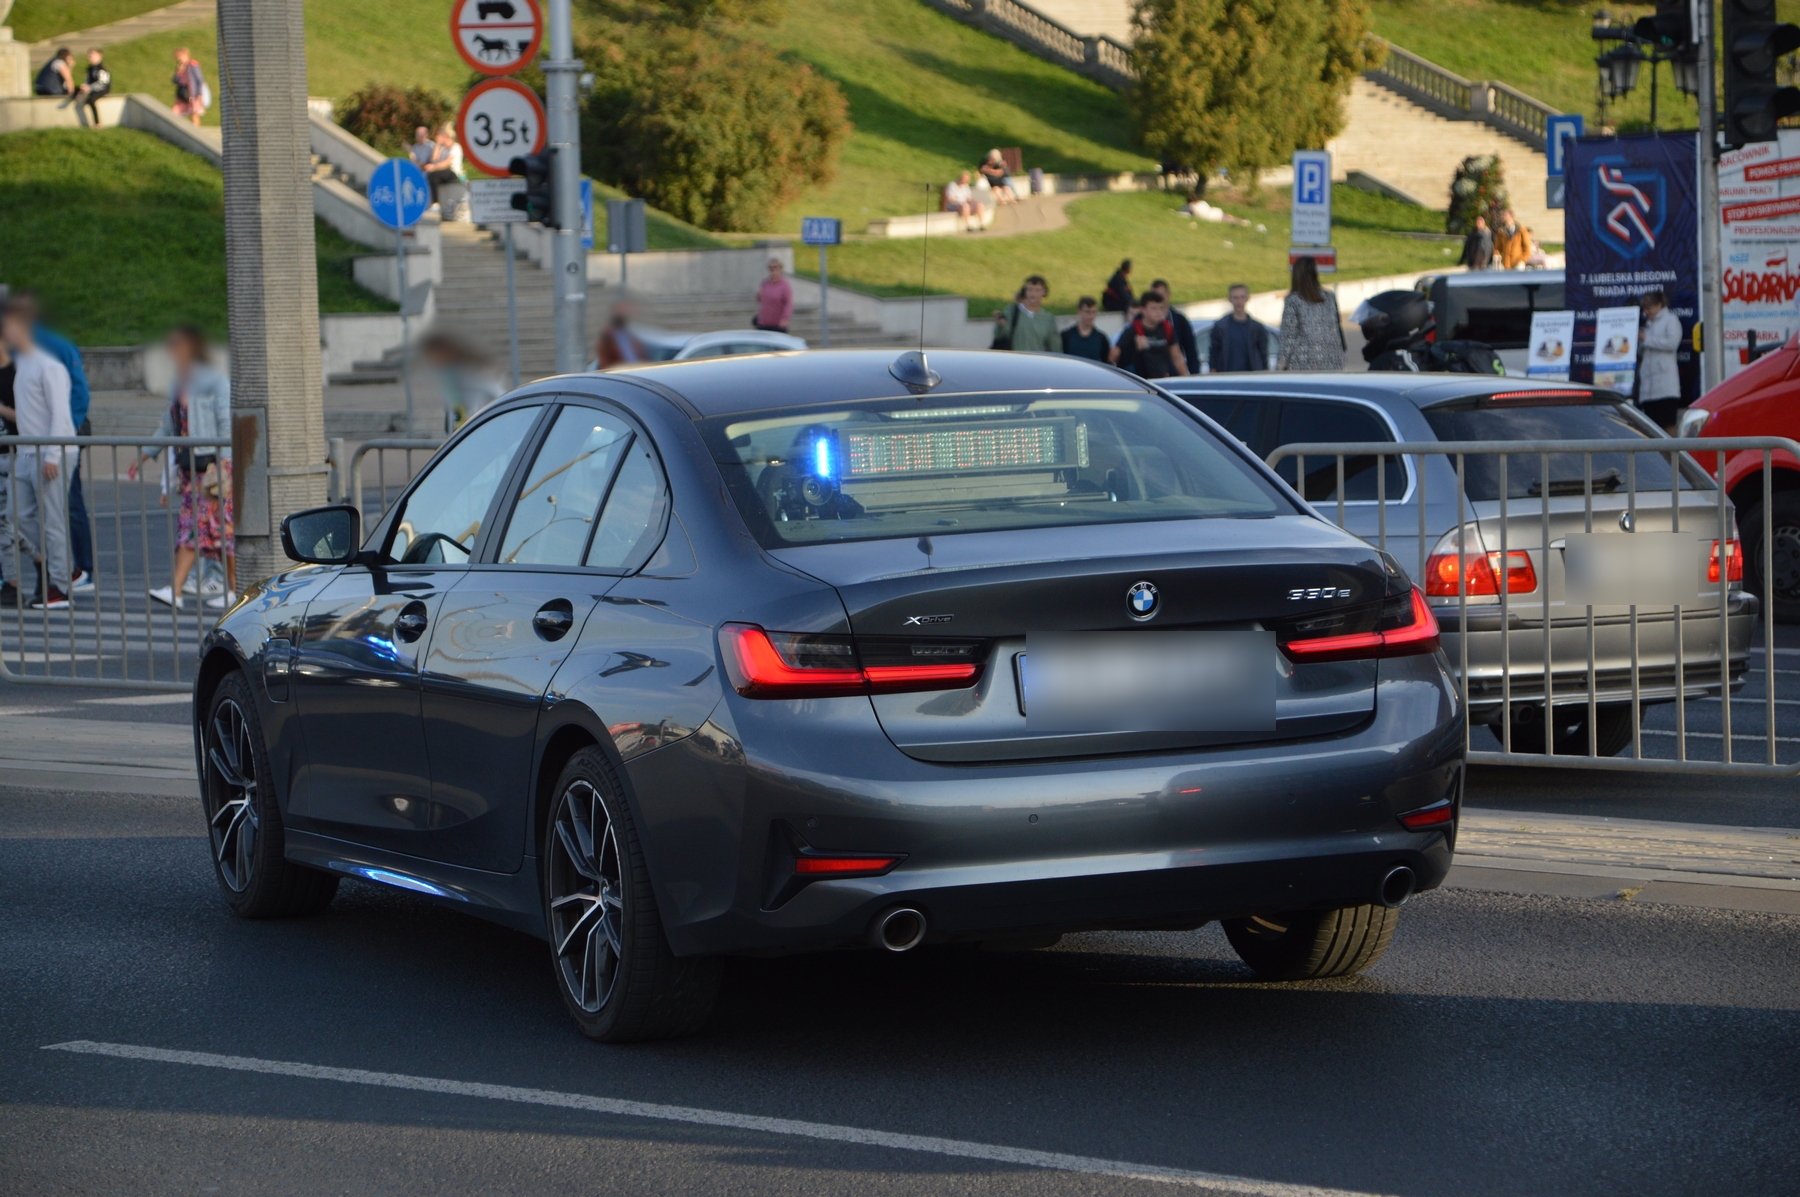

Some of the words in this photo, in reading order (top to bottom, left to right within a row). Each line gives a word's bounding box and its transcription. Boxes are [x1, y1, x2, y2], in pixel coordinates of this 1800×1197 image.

[1719, 146, 1770, 168] RACOWNIK
[1749, 164, 1779, 179] POMOC
[1302, 162, 1321, 201] P
[1718, 187, 1747, 197] ARUNKI
[1727, 206, 1747, 219] STOP
[1588, 271, 1633, 285] LUBELSKA
[1634, 270, 1677, 283] BIEGOWA
[1592, 285, 1626, 298] TRIADA
[954, 428, 1041, 469] DOWN
[1286, 587, 1351, 600] 330e
